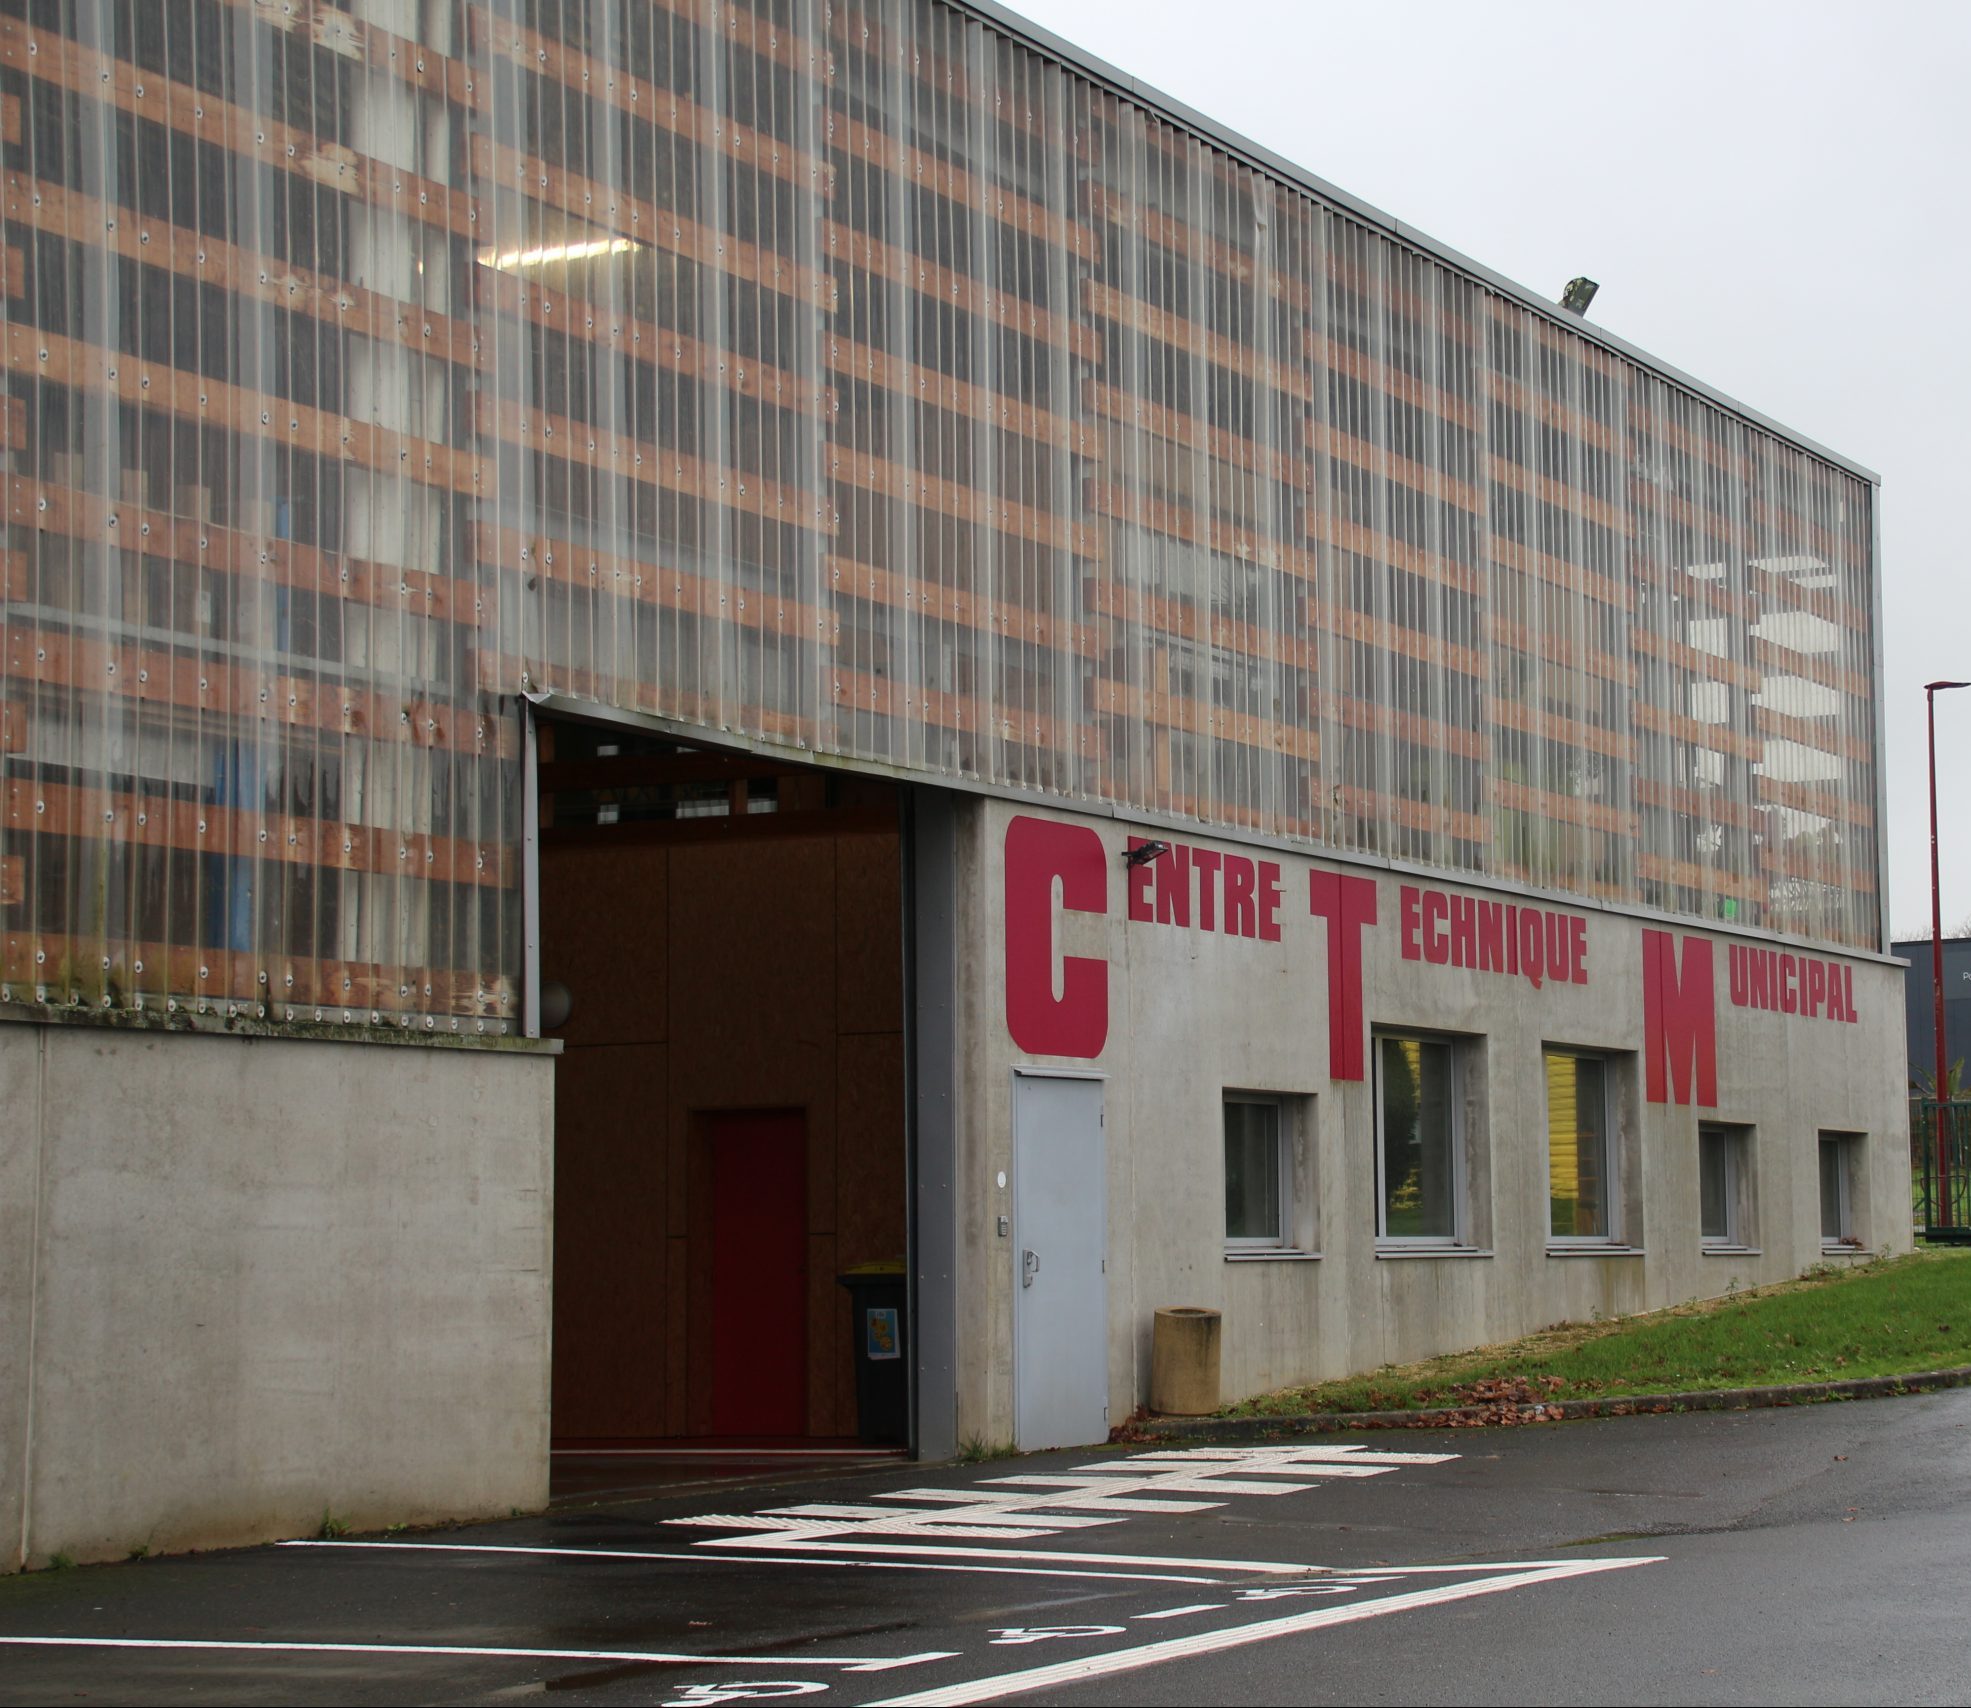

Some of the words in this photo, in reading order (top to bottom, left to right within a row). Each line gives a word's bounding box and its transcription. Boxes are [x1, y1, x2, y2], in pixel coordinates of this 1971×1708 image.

[1005, 815, 1281, 1059] CENTRE
[1310, 869, 1588, 1081] TECHNIQUE
[1642, 928, 1858, 1107] MUNICIPAL
